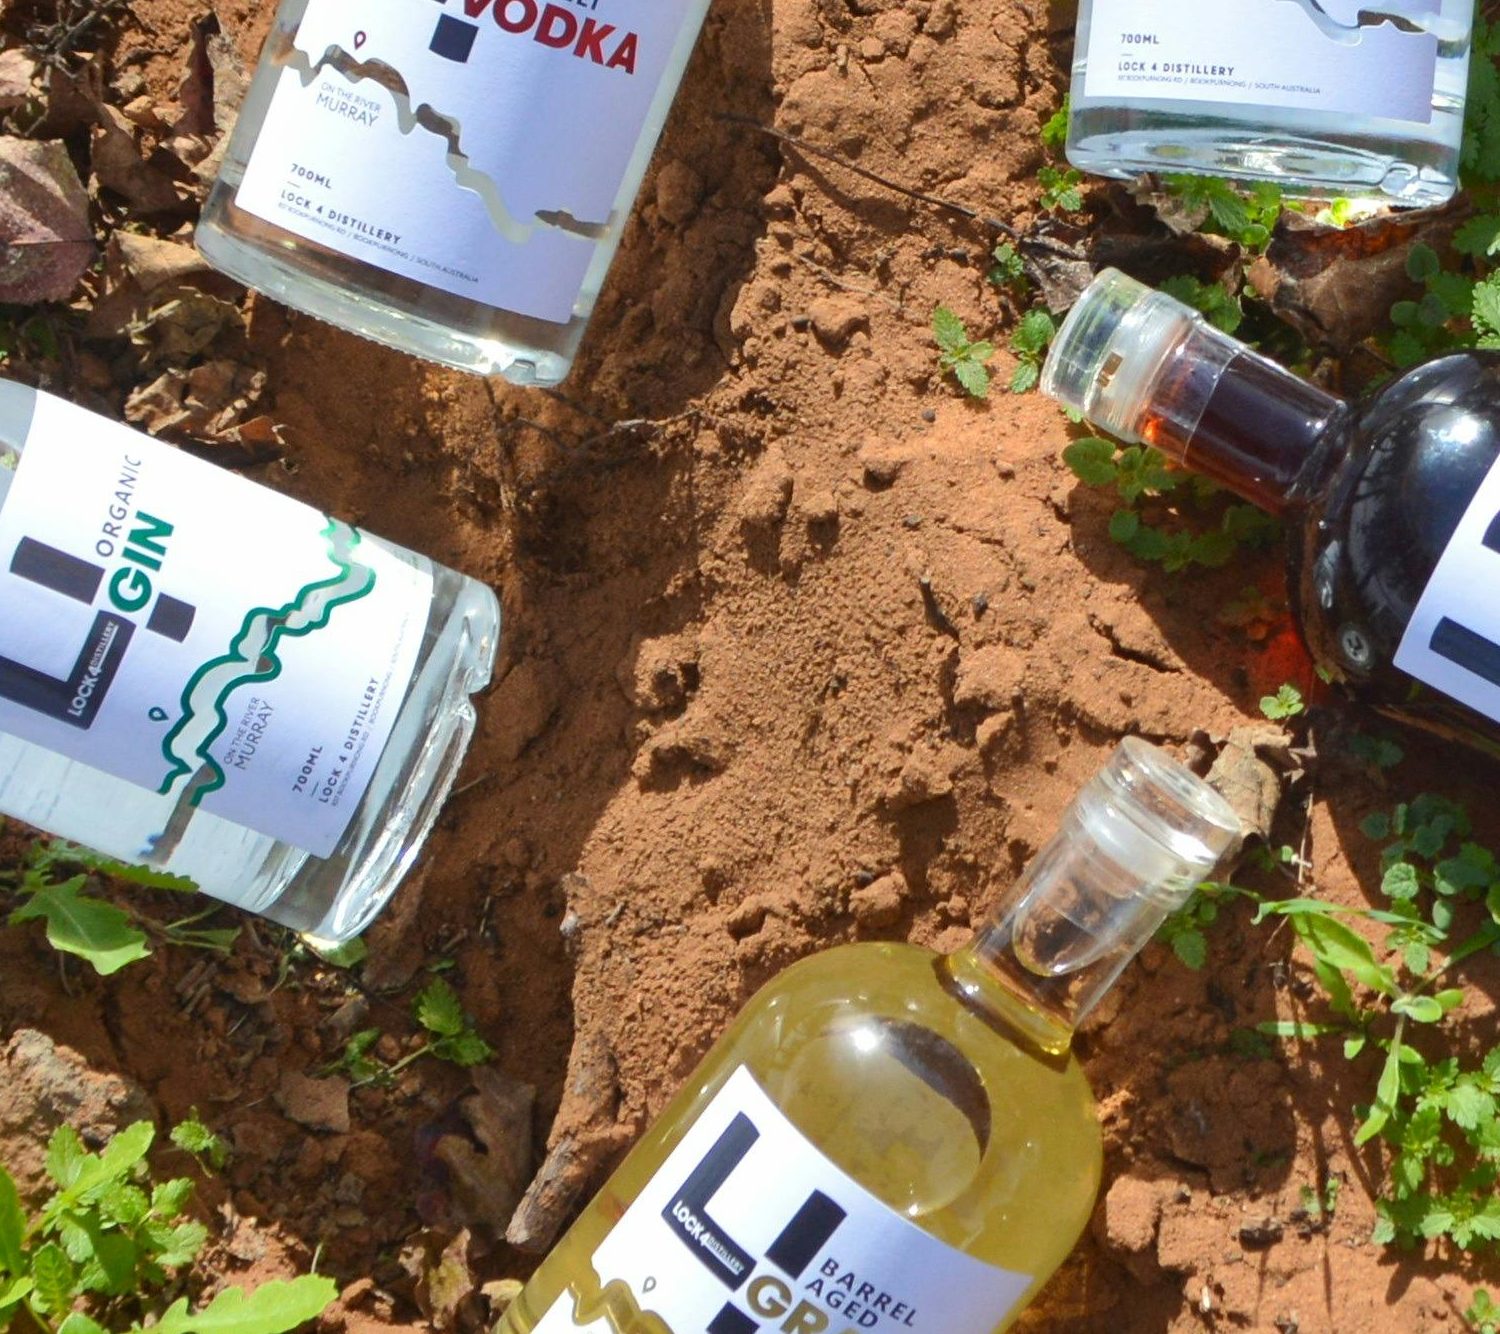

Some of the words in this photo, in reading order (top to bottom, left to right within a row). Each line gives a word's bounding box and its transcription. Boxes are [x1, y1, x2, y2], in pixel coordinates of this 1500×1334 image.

[1120, 33, 1160, 45] 700ML
[1117, 60, 1148, 71] LOCK
[1150, 61, 1158, 72] 4
[1162, 62, 1235, 76] DISTILLERY
[314, 92, 378, 128] MURRAY
[319, 81, 335, 96] ON
[334, 87, 353, 103] THE
[352, 95, 381, 114] RIVER
[289, 163, 334, 189] 700ML
[279, 189, 313, 211] LOCK
[314, 204, 324, 215] 4
[326, 209, 402, 245] DISTILLERY
[93, 453, 142, 560] ORGANIC
[102, 508, 175, 619] GIN
[89, 619, 116, 667] DISTILLERY
[222, 746, 237, 765] ON
[230, 728, 246, 748] THE
[238, 695, 260, 729] RIVER
[234, 698, 276, 772] MURRAY
[342, 676, 380, 750] DISTILLERY
[292, 742, 323, 794] 700ML
[318, 765, 343, 804] LOCK
[337, 753, 349, 764] 4
[803, 1274, 881, 1331] AGED
[818, 1256, 921, 1328] BARREL
